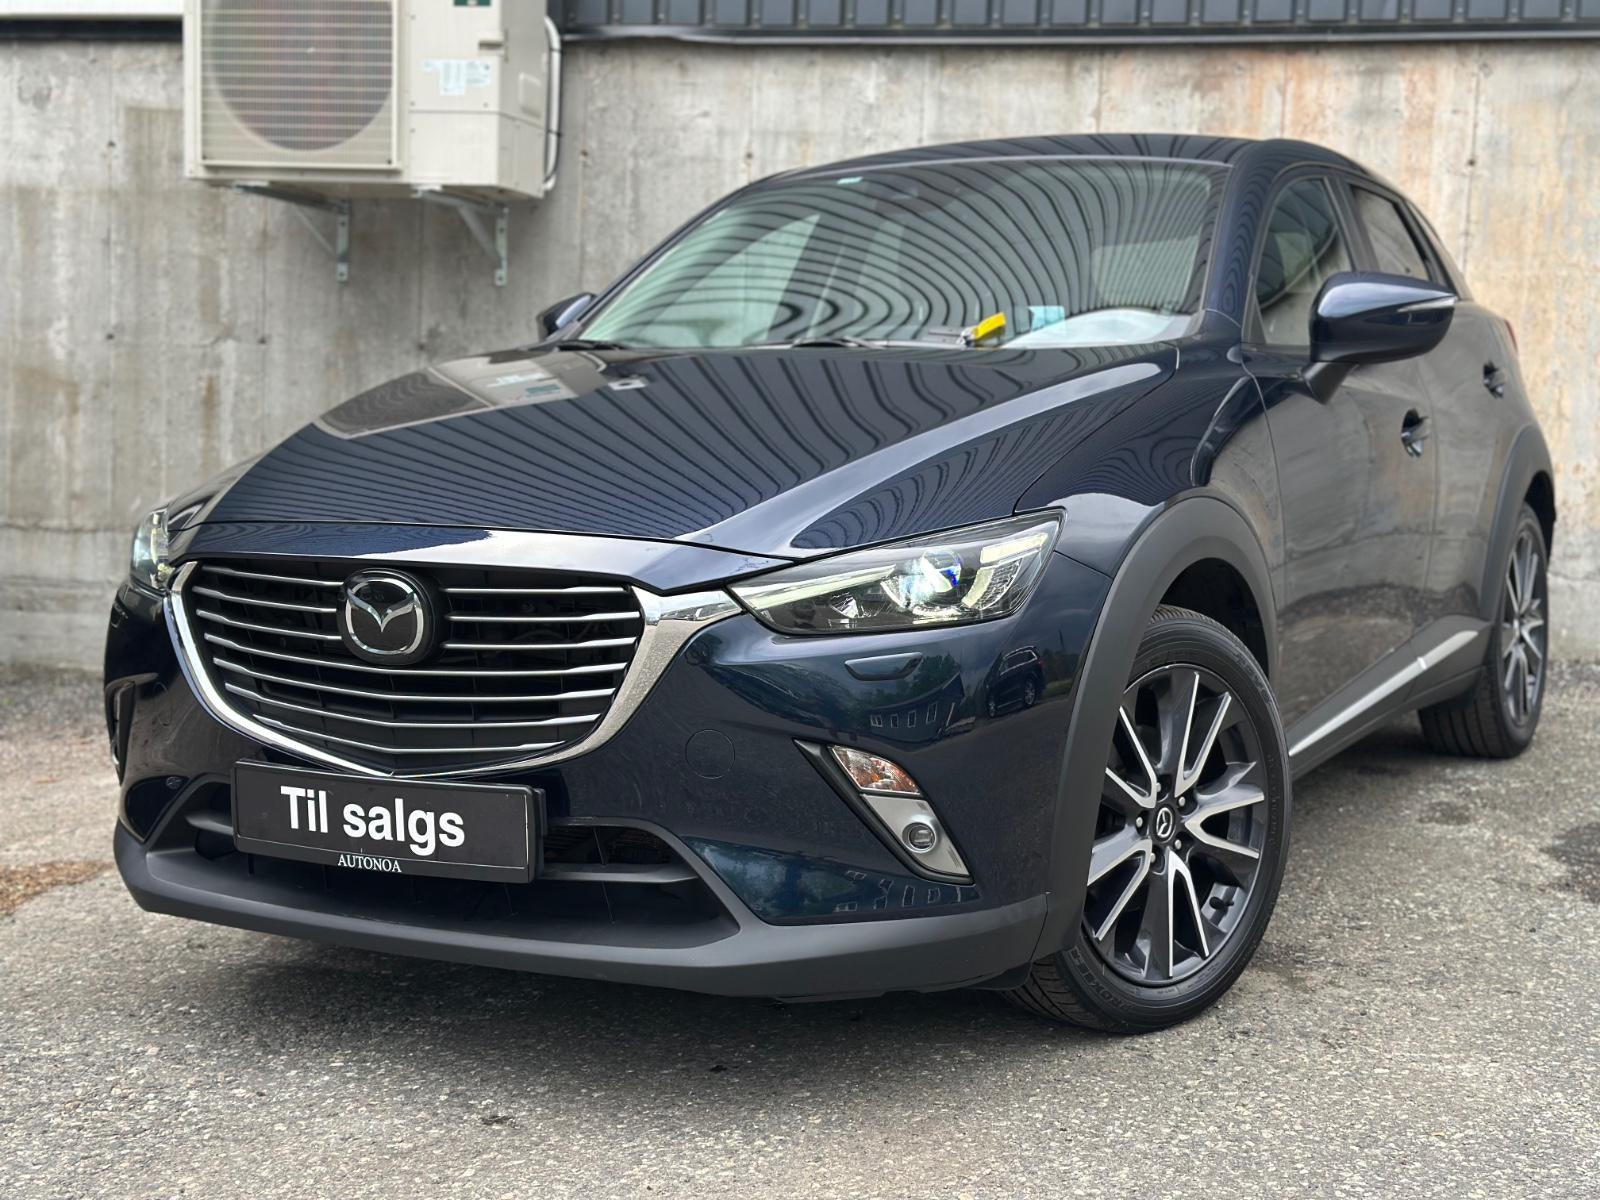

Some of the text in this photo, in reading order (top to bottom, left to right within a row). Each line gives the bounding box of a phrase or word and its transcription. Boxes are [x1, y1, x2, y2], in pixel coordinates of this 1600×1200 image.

[281, 785, 465, 856] Til salgs
[337, 853, 402, 873] AUTONOA
